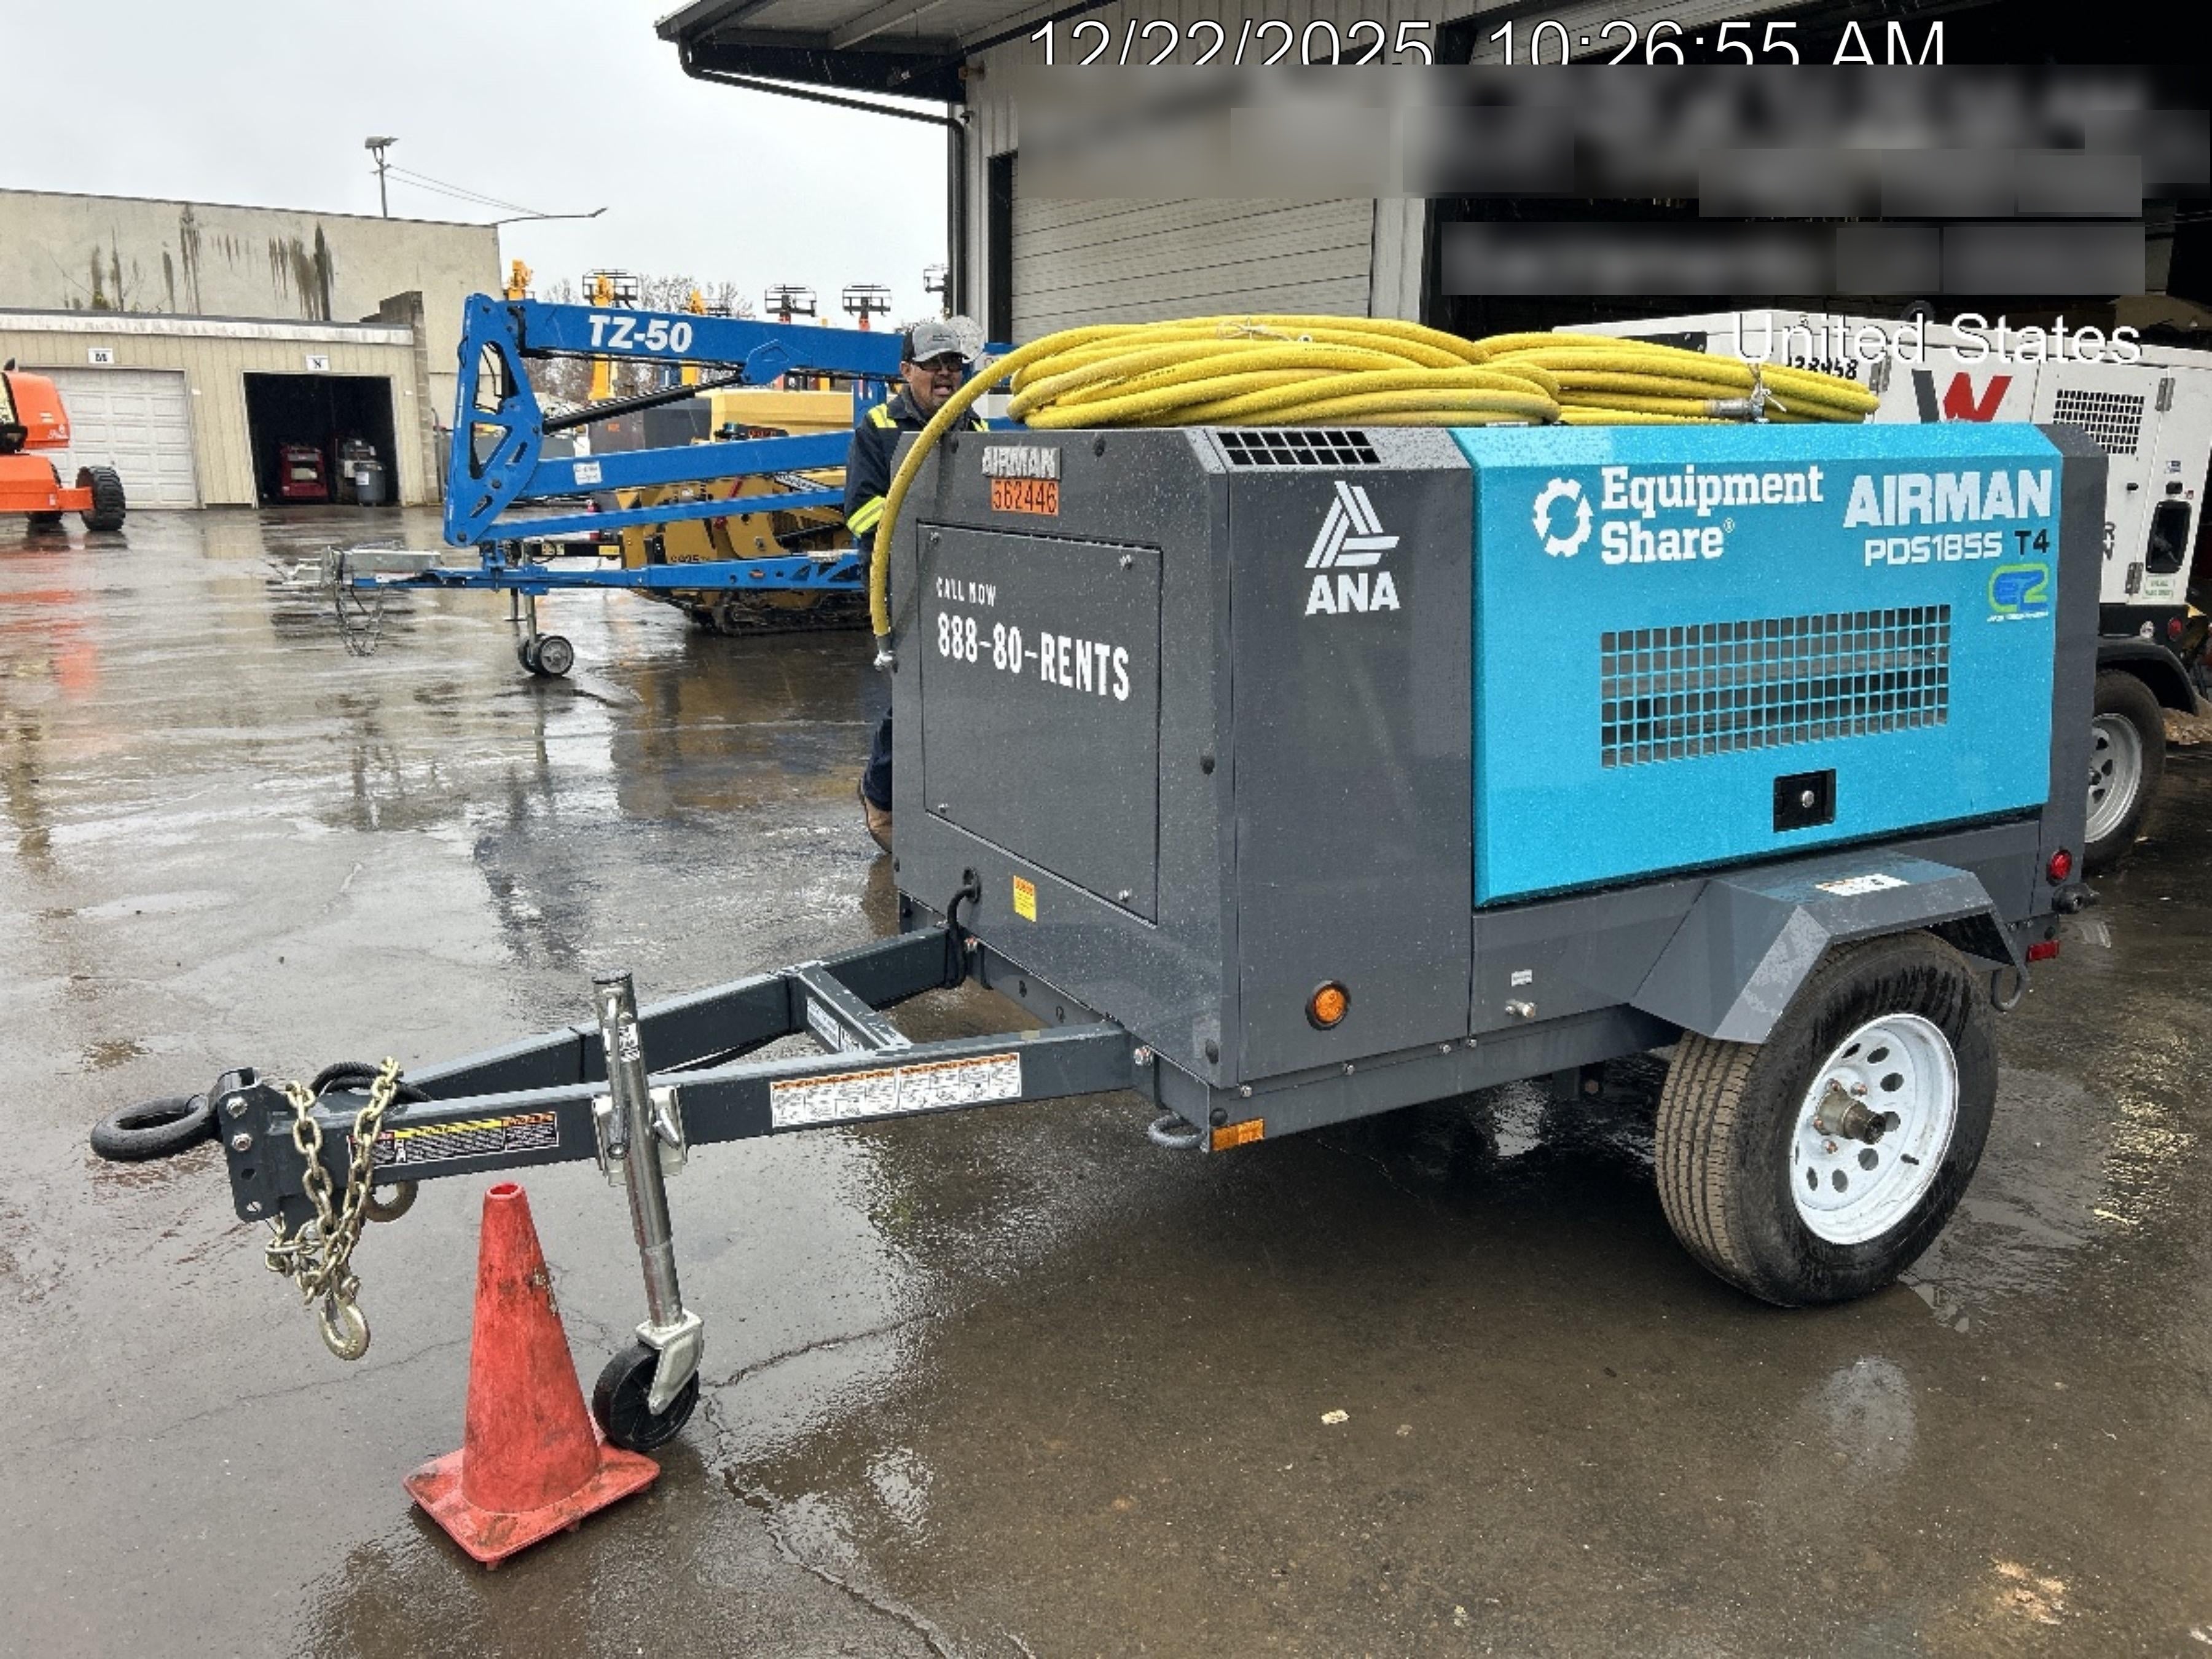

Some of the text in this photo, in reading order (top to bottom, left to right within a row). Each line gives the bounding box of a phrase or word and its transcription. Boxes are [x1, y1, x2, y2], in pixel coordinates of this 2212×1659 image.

[588, 314, 692, 353] TZ-50
[982, 447, 1057, 477] AIRMAN
[994, 480, 1056, 512] 562446
[1601, 465, 1824, 519] Equipment
[1843, 469, 2052, 528] AIRMAN
[1864, 528, 2050, 567] PDS185S T4
[936, 576, 996, 607] CALL NOW
[1304, 571, 1401, 616] ANA
[938, 612, 1131, 701] 888-80-RENTS
